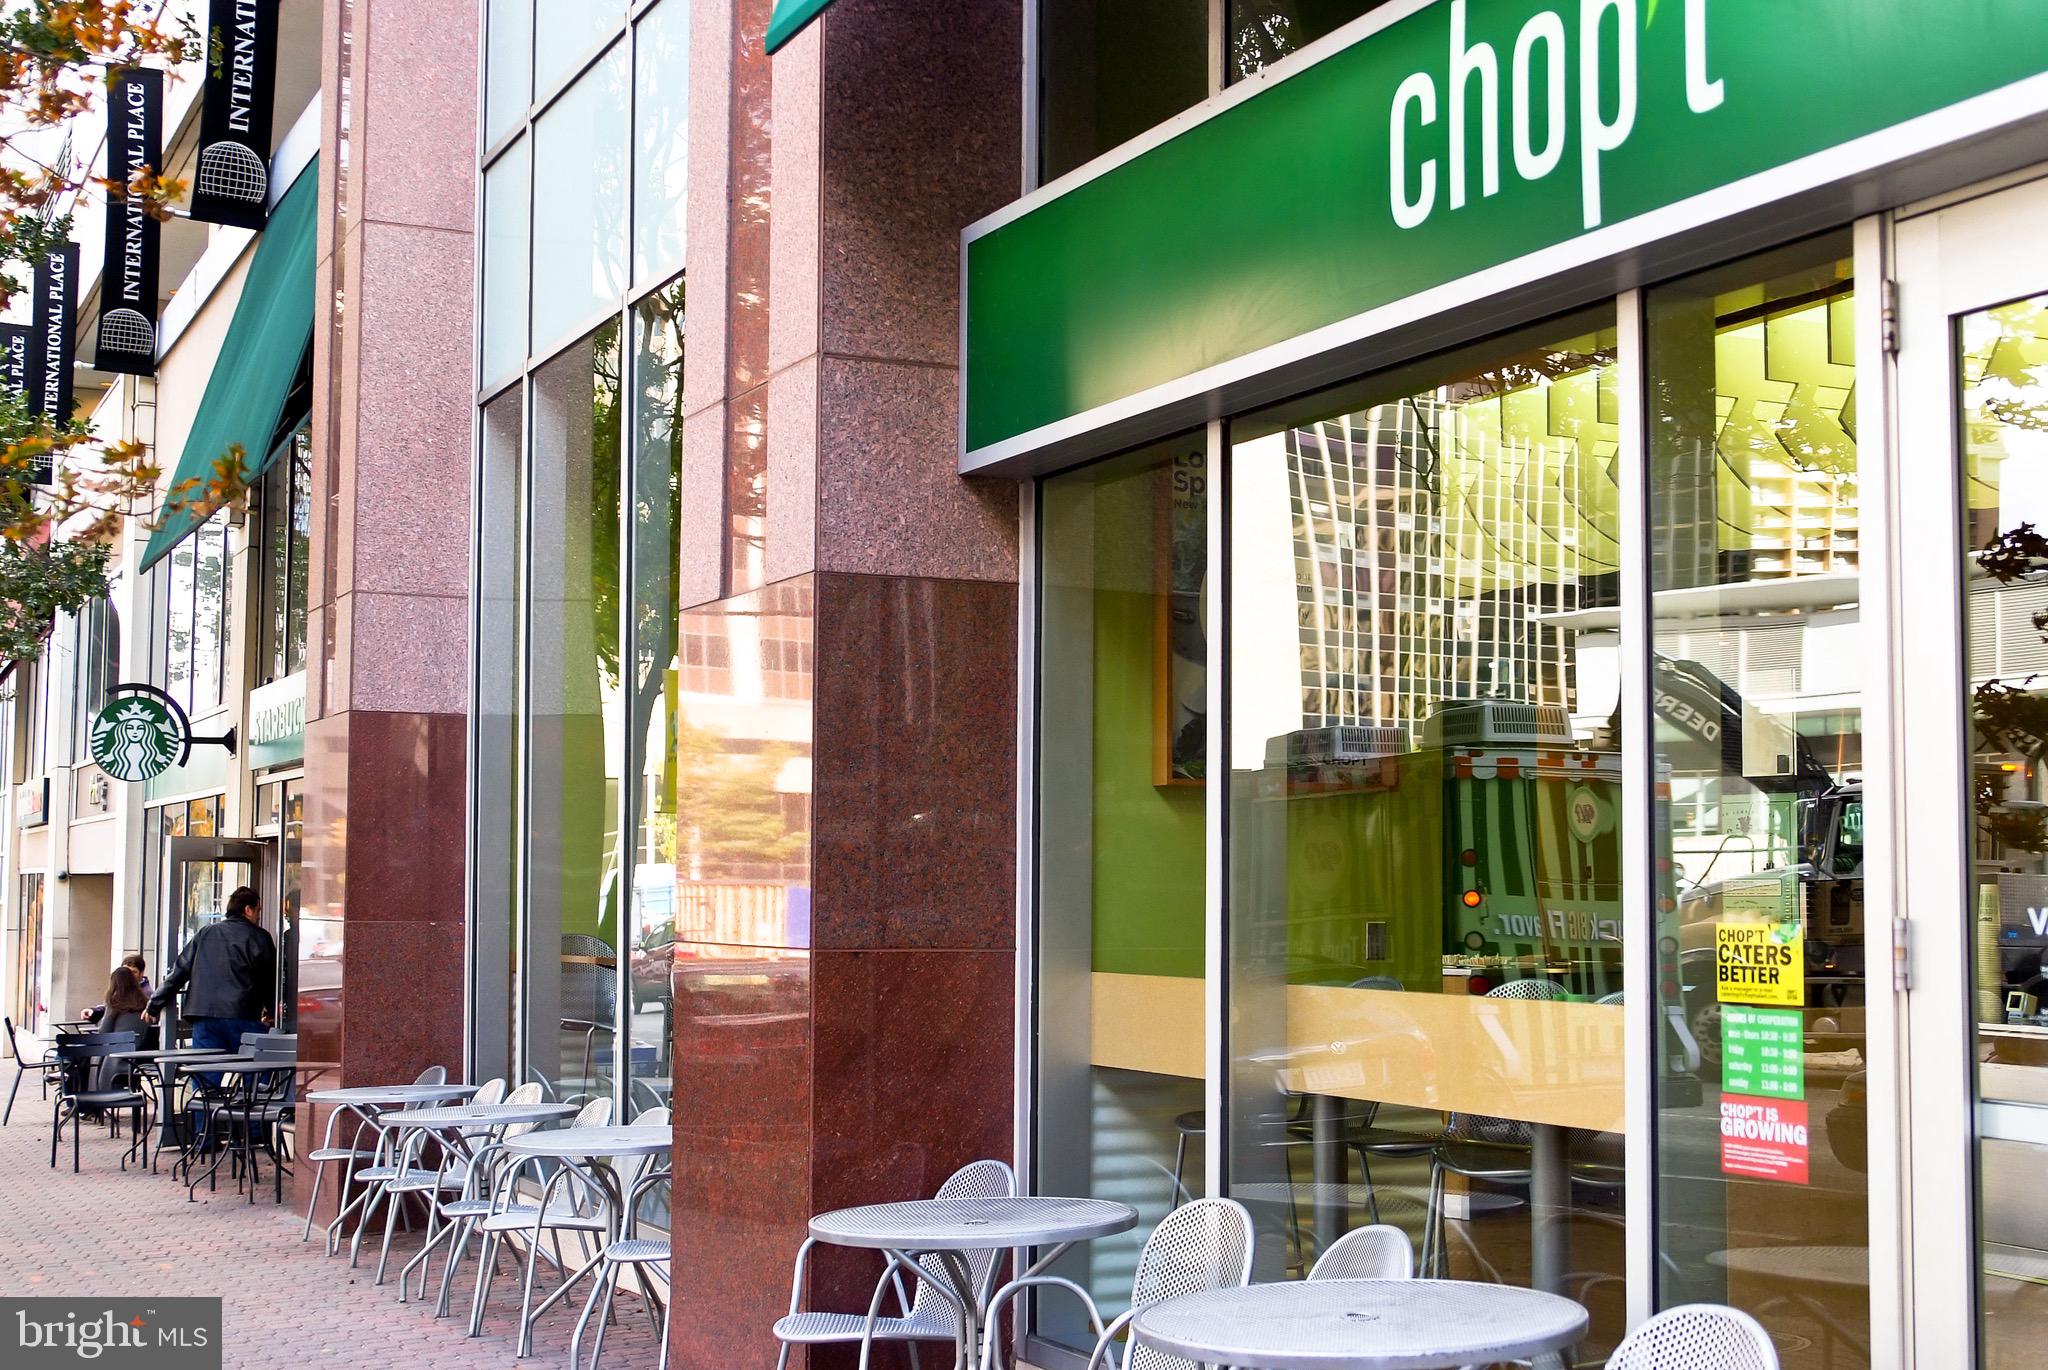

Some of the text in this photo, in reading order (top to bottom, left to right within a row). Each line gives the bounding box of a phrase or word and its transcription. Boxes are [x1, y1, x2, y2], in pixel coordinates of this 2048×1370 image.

[127, 82, 145, 141] PLACE
[1389, 0, 1725, 230] chopt
[43, 253, 65, 428] NTERNATIONAL PLACE
[11, 335, 25, 377] PLACE
[1719, 929, 1765, 943] CHOP'T
[1719, 944, 1792, 966] CATERS
[1719, 965, 1780, 985] BETTER
[1720, 1102, 1779, 1122] CHOP'T IS
[1720, 1116, 1808, 1146] GROWING
